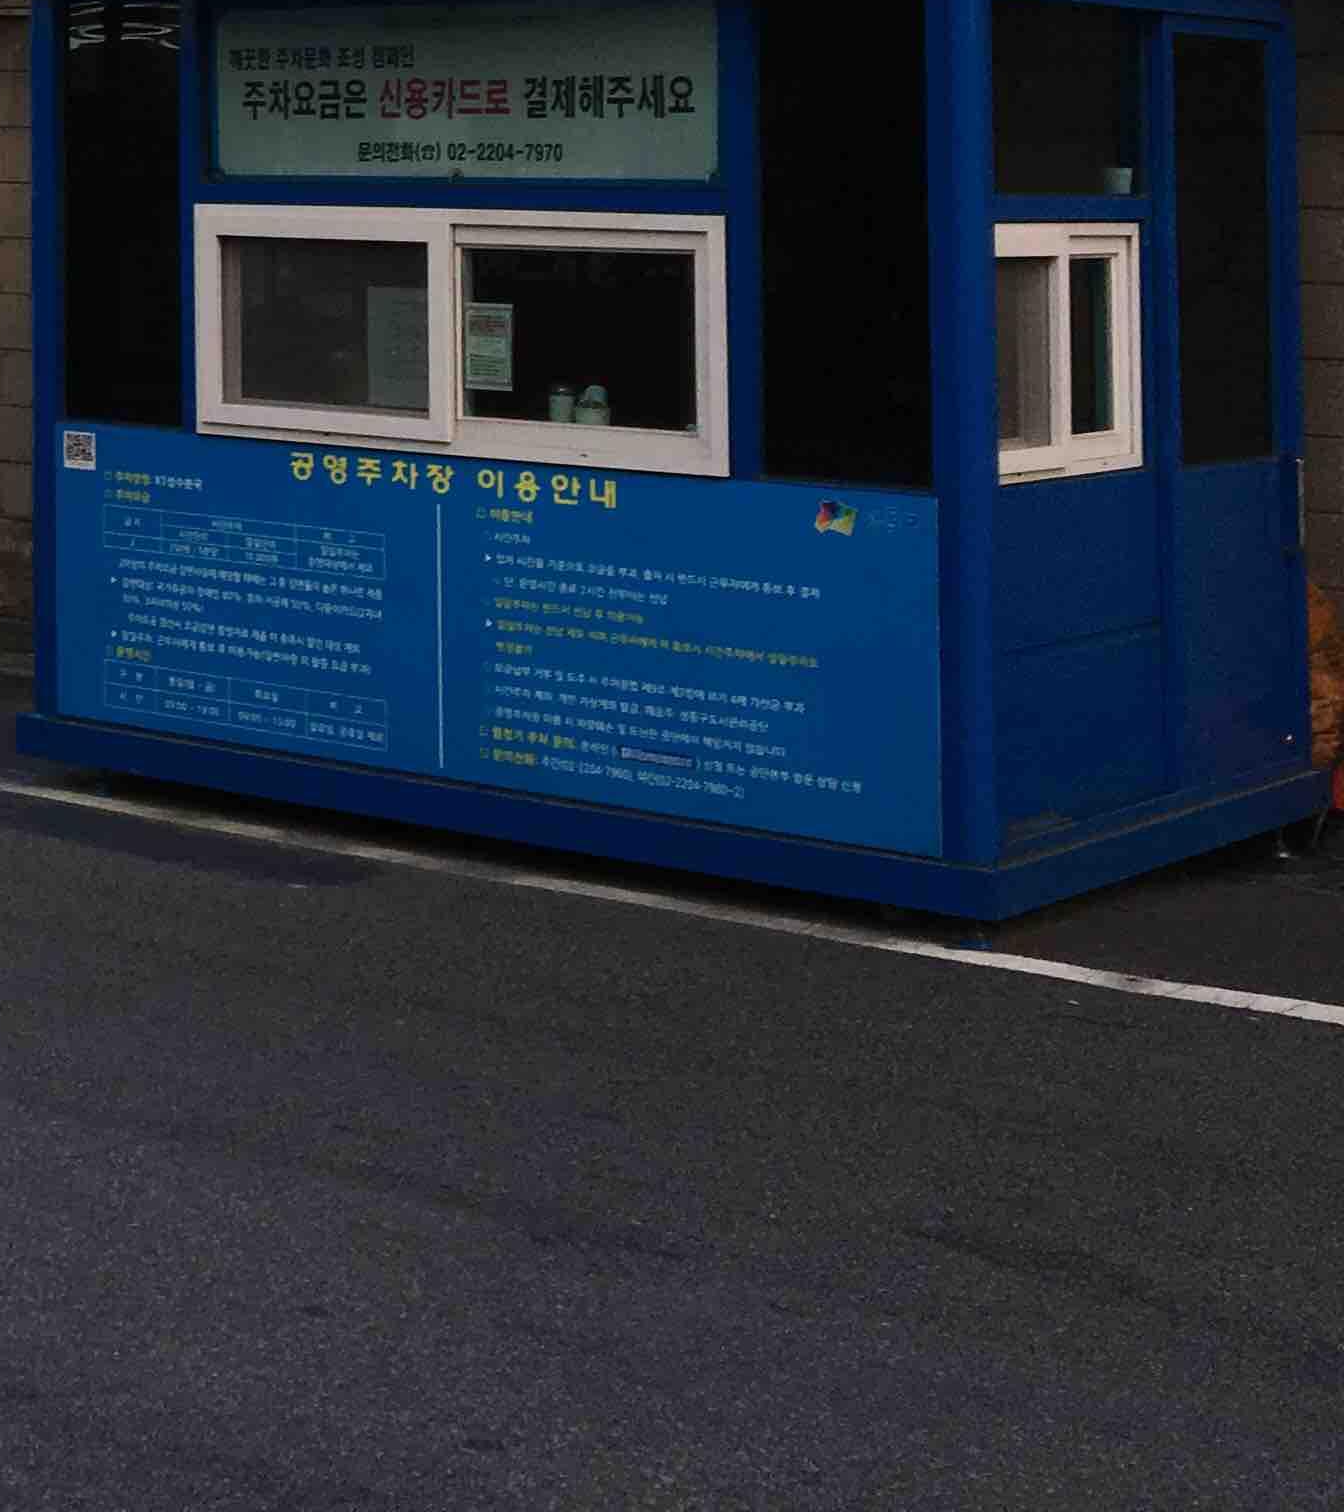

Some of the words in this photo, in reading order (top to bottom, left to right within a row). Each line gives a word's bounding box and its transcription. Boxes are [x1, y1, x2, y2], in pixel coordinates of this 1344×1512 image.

[242, 79, 368, 121] 주차요금은
[379, 77, 512, 121] 신용카드로
[523, 74, 697, 120] 결제해주세요
[446, 142, 564, 163] 02-2204-7970
[290, 450, 455, 495] 공영주차장
[475, 469, 618, 509] 이용안내
